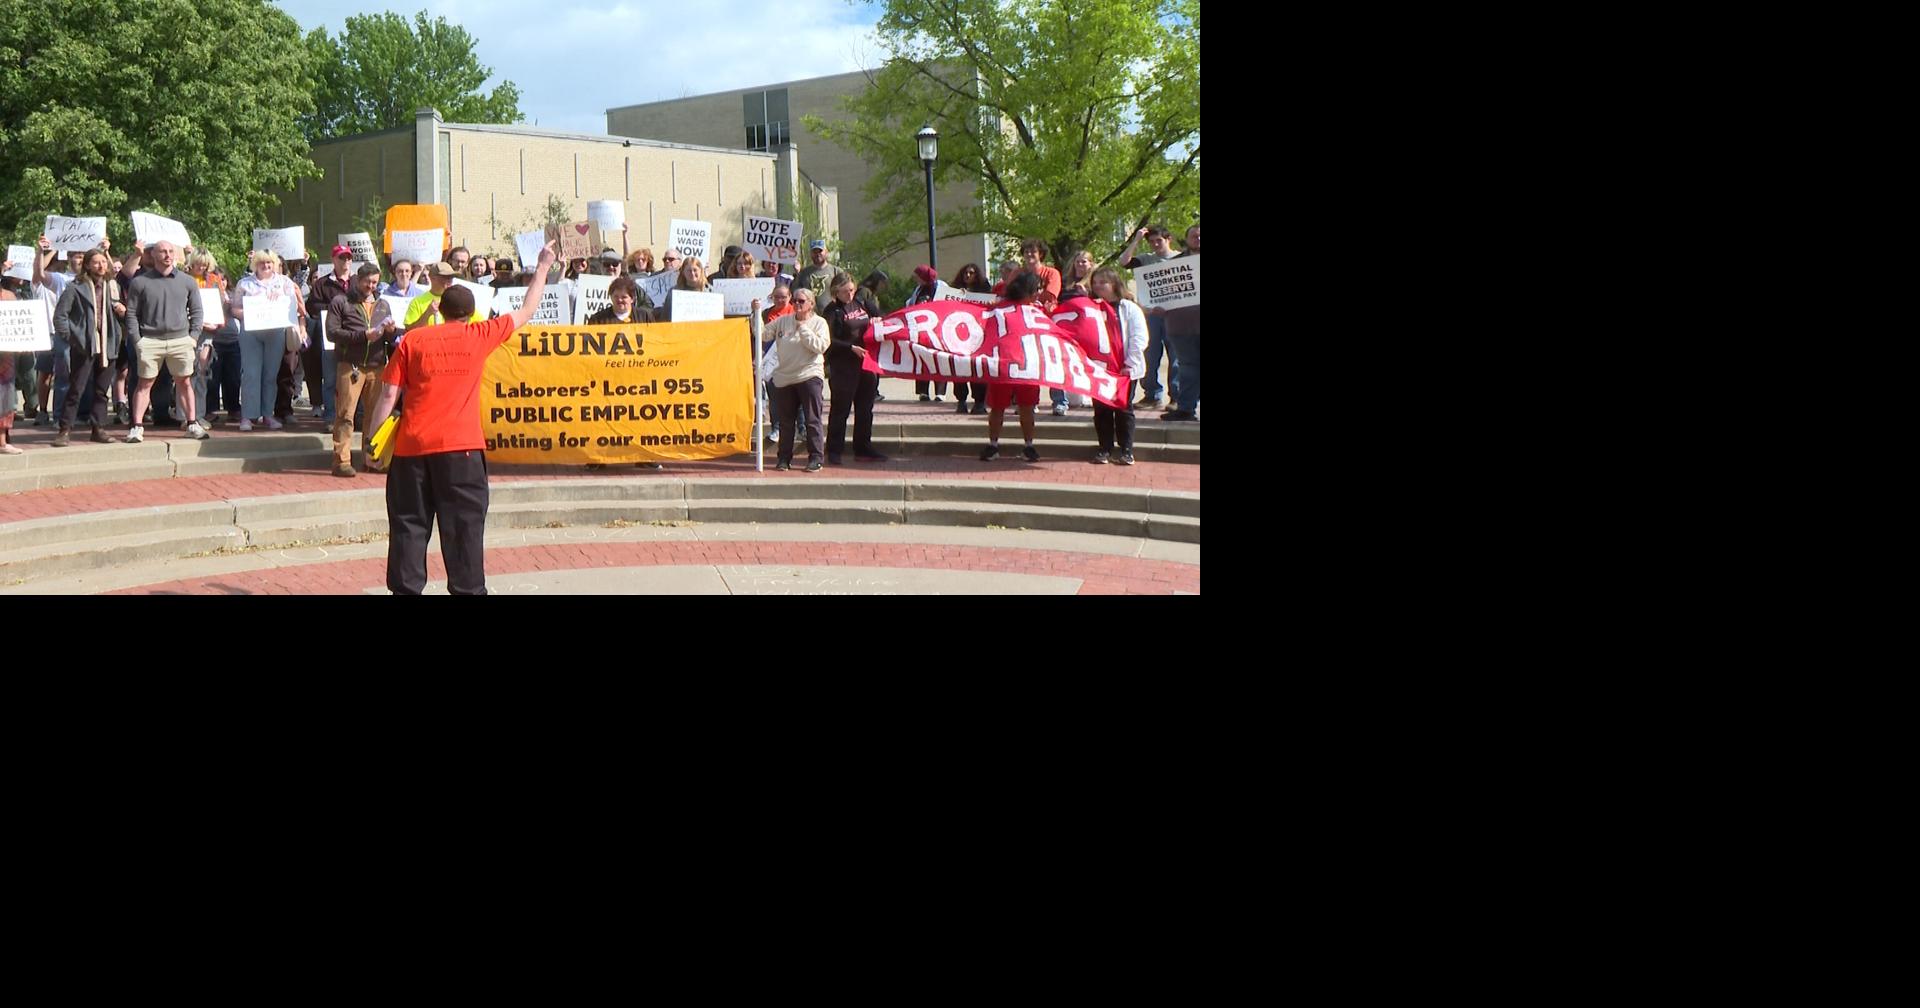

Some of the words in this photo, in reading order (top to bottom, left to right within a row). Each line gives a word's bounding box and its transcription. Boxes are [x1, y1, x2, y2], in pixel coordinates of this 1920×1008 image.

[62, 220, 83, 231] PAY
[676, 228, 706, 237] LIVING
[749, 218, 790, 236] VOTE
[56, 233, 95, 243] WORK
[677, 237, 704, 247] WAGE
[746, 232, 798, 251] UNION
[675, 246, 704, 257] NOW
[764, 245, 798, 259] YES
[1143, 264, 1193, 280] ESSENTIAL
[1147, 273, 1193, 288] WORKERS
[586, 288, 609, 299] LIVI
[1149, 282, 1195, 298] DESERVE
[1183, 291, 1197, 299] PAY
[518, 331, 645, 358] LiUNA!
[605, 358, 626, 368] Feel
[628, 358, 645, 368] the
[647, 358, 680, 368] Power
[1008, 333, 1118, 400] JOBS
[495, 380, 596, 399] Laborers'
[603, 379, 658, 397] Local
[664, 378, 704, 395] 955
[490, 405, 573, 424] PUBLIC
[580, 403, 711, 423] EMPLOYEES
[485, 433, 553, 451] ghting
[558, 431, 590, 448] for
[596, 434, 634, 448] our
[640, 429, 736, 447] members
